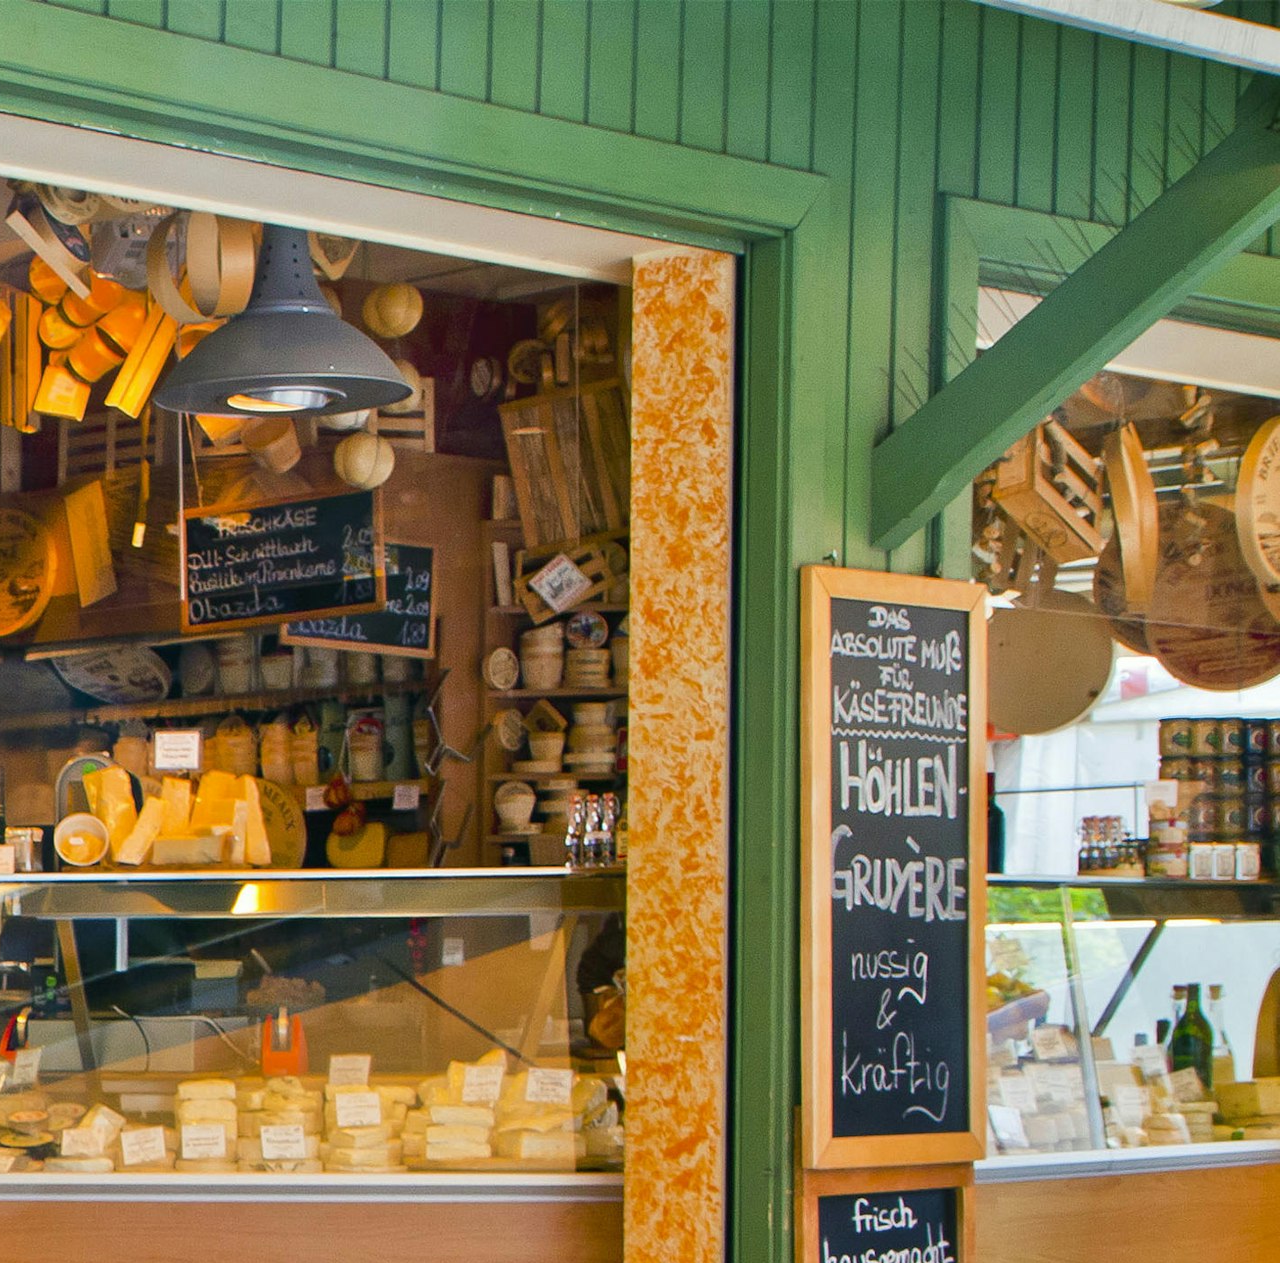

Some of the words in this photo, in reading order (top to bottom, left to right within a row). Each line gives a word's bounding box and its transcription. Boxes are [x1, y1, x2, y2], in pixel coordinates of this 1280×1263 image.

[866, 605, 912, 631] DAS
[830, 629, 917, 664] ABSOLUTE
[877, 662, 914, 692] FÜR
[833, 680, 967, 732] KÄSEFREUNDE
[831, 823, 968, 923] GRUYÈRE
[850, 938, 930, 1005] nussig
[876, 988, 898, 1030] &
[841, 1029, 951, 1122] kräftig
[851, 1196, 918, 1233] frisch
